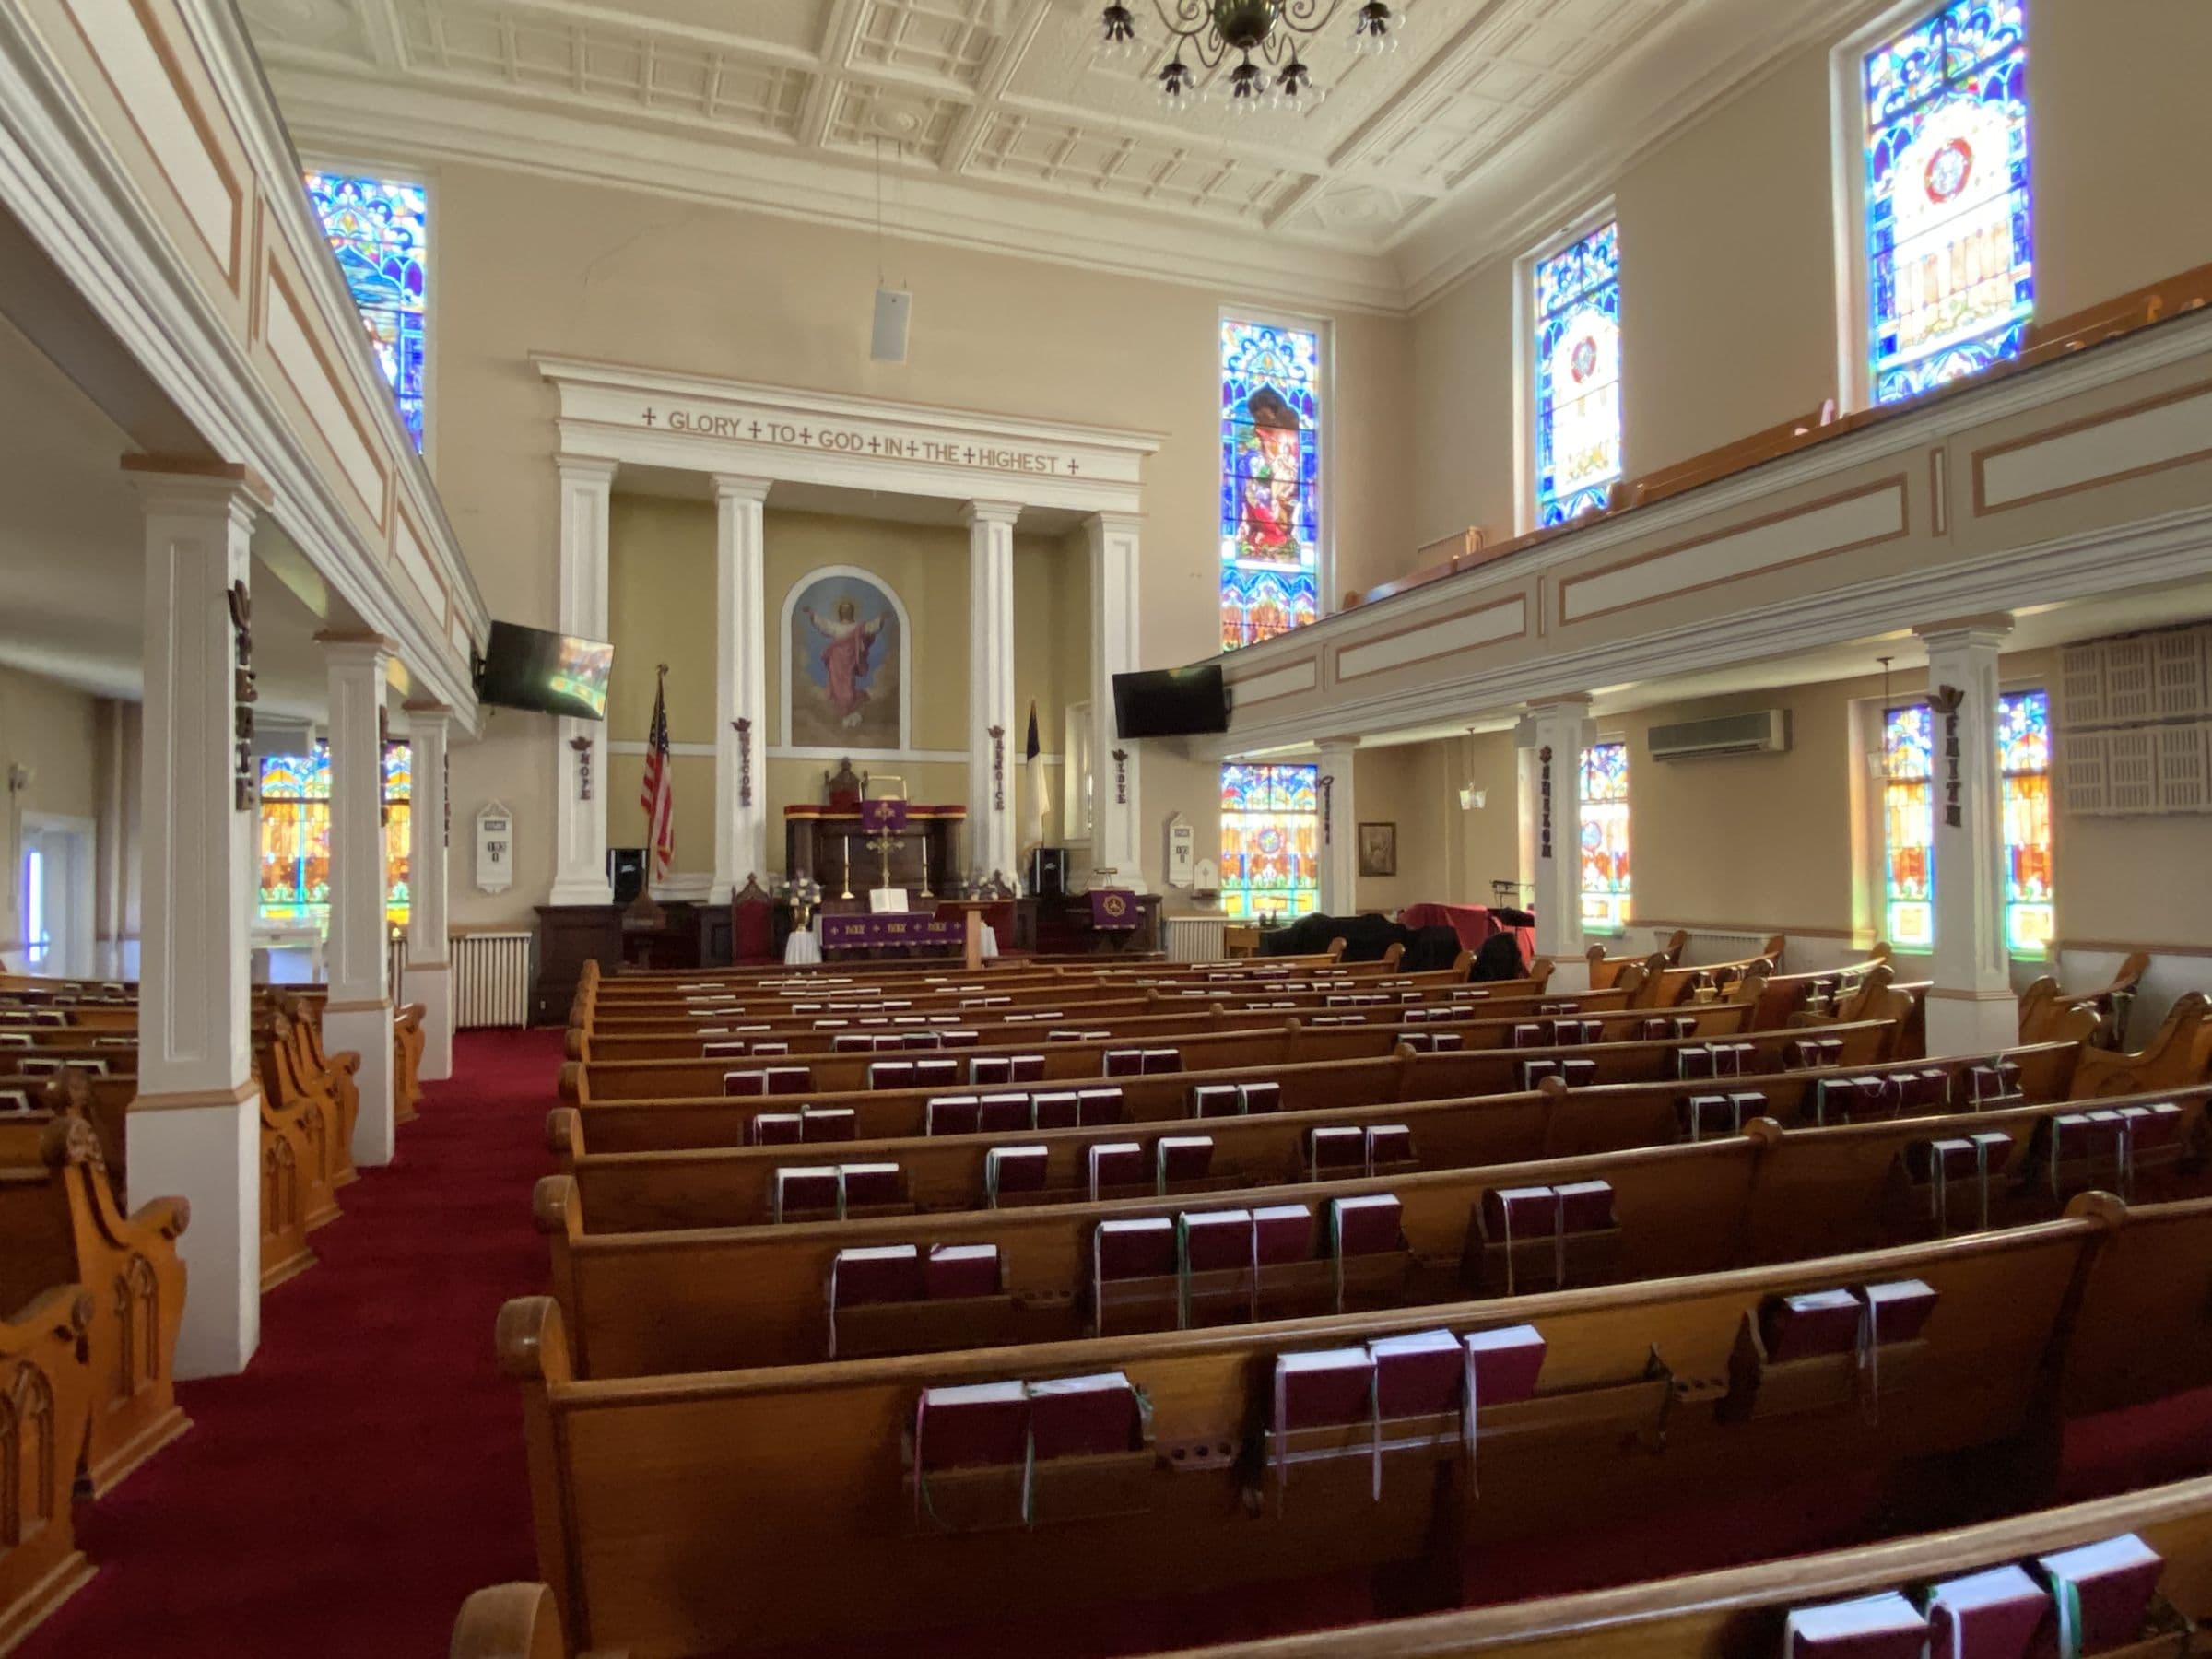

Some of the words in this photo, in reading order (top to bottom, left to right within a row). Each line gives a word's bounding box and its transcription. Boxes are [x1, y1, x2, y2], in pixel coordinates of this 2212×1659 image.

[668, 410, 741, 437] GLORY
[767, 422, 796, 443] TO
[818, 429, 864, 451] GOD
[884, 438, 903, 456] IN
[922, 441, 959, 463] THE
[979, 449, 1059, 474] HIGHEST
[1116, 761, 1126, 805] LOVE
